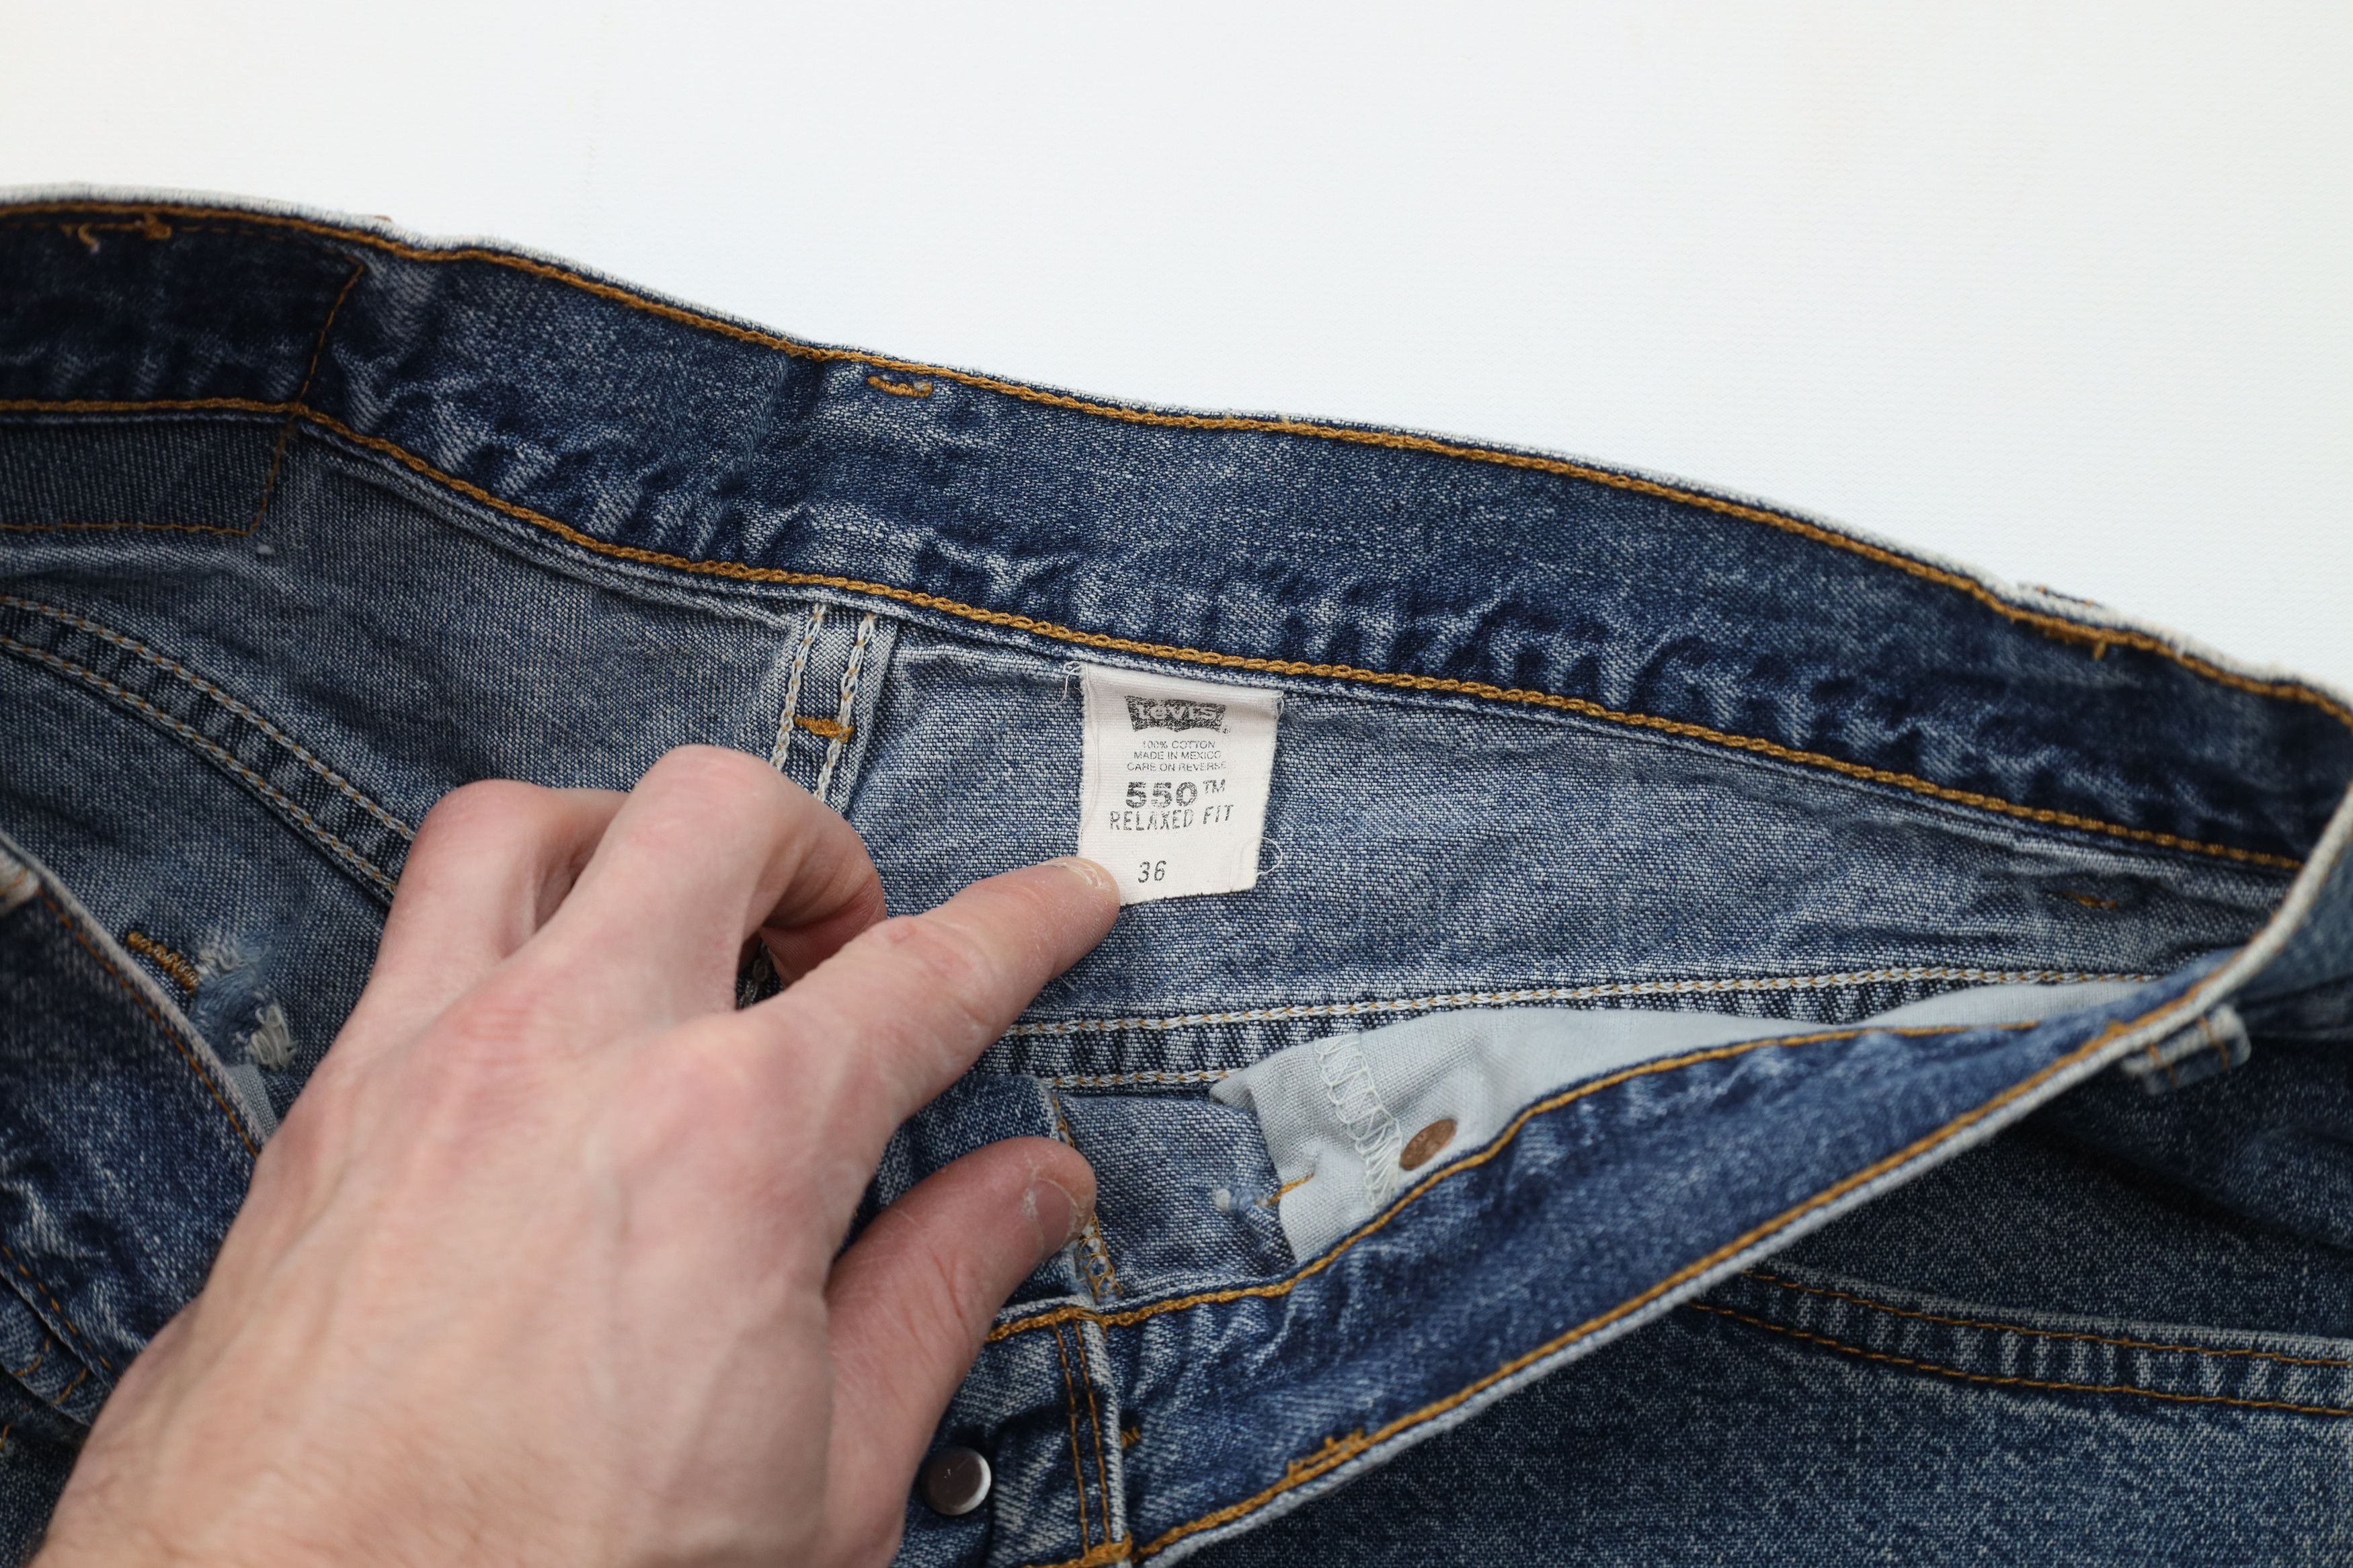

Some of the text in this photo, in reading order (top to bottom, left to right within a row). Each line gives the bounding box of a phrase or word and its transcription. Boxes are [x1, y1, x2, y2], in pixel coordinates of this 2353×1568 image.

[1172, 741, 1215, 749] COTTON
[1133, 751, 1222, 760] MADE IN MEXICO
[1127, 761, 1226, 771] CARE ON REVERSE
[1109, 804, 1234, 831] RELAXED FIT
[1138, 860, 1166, 882] 36
